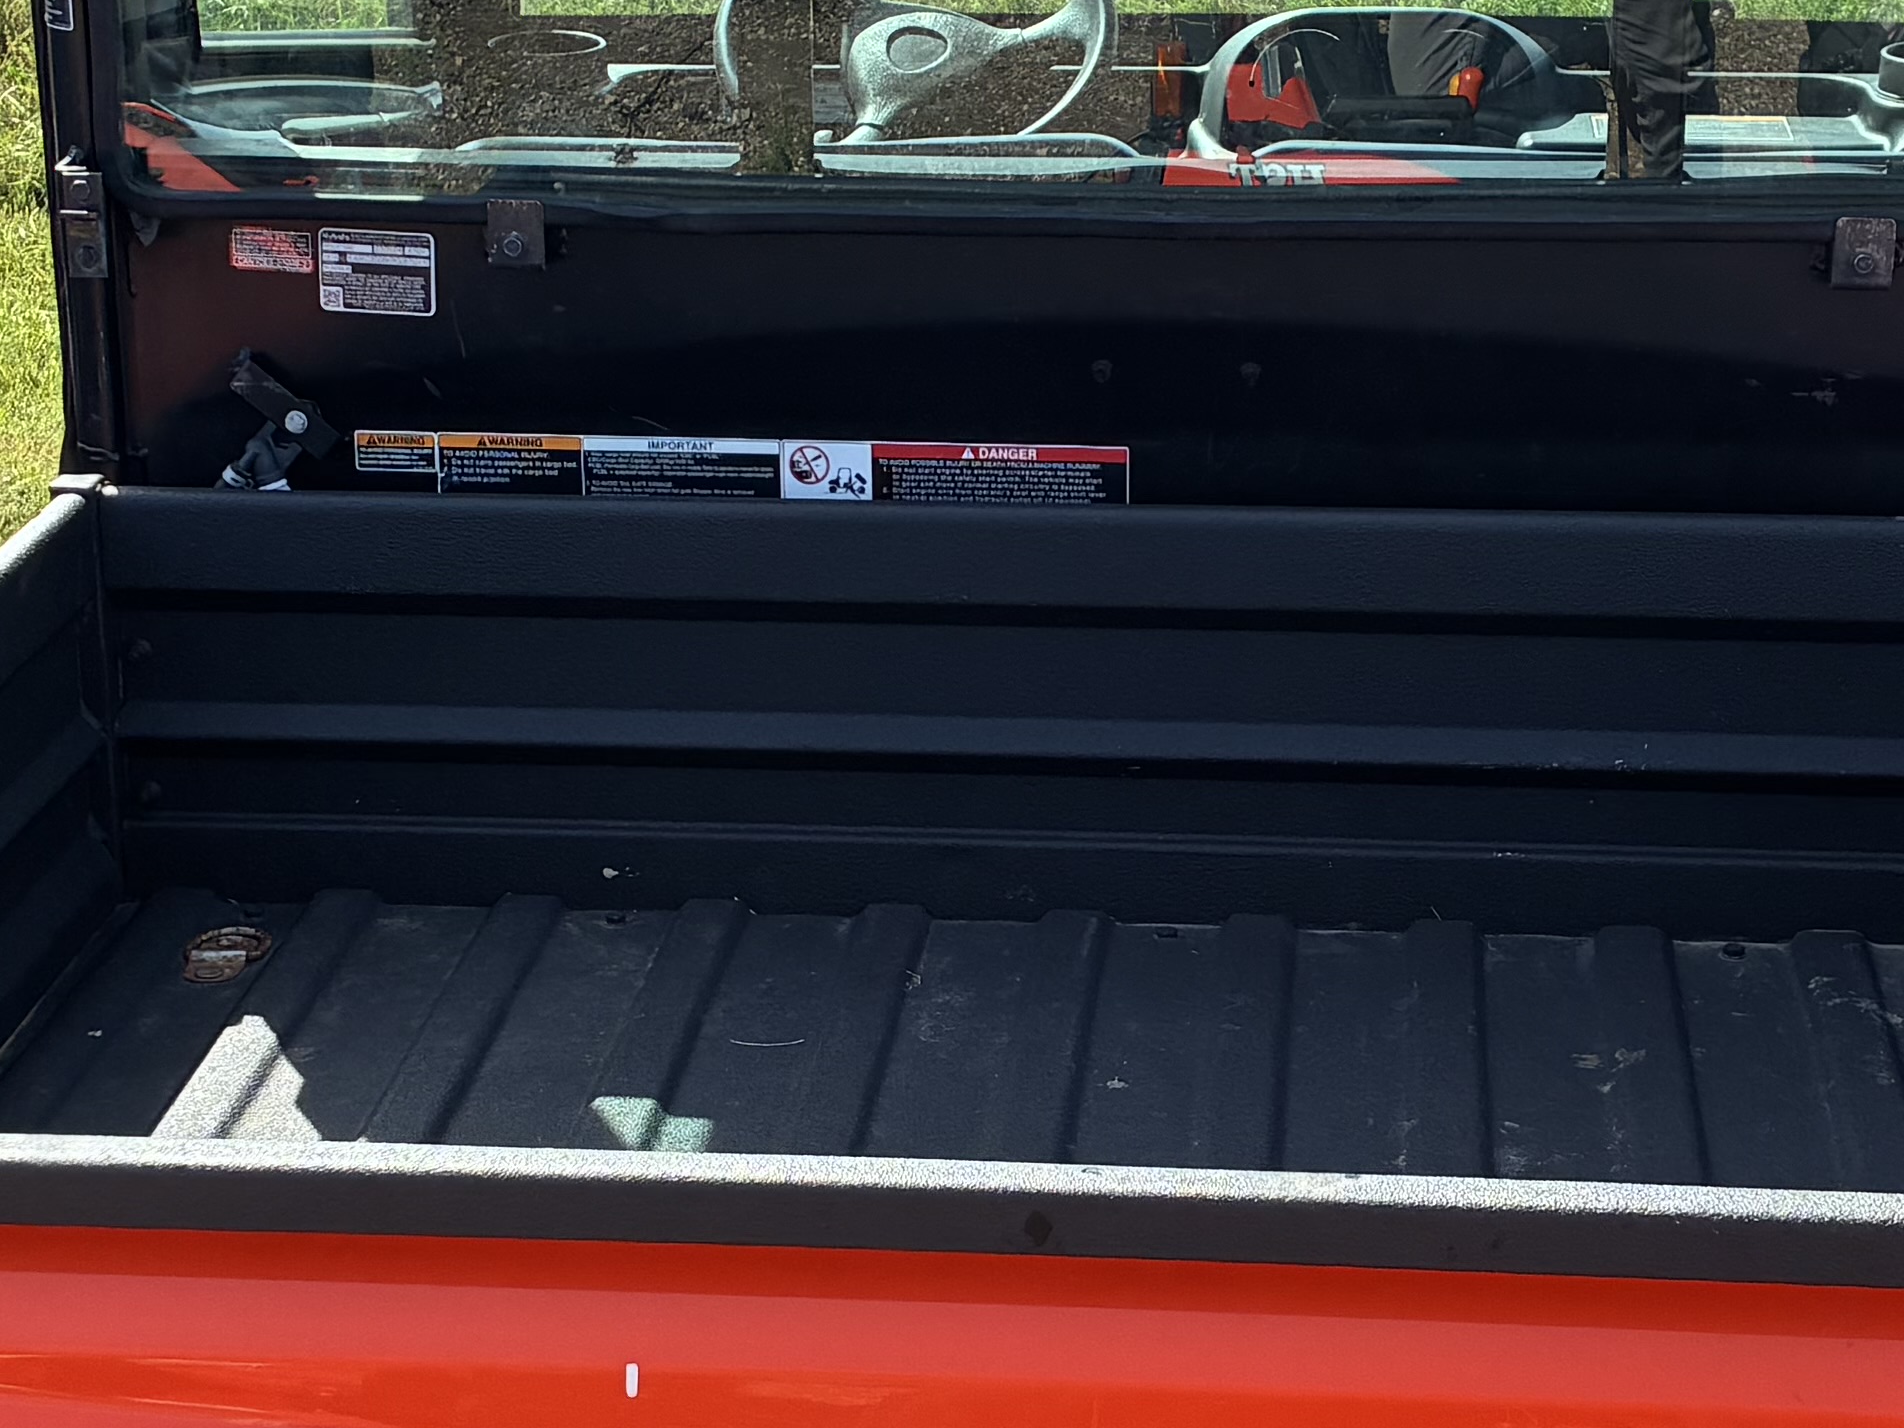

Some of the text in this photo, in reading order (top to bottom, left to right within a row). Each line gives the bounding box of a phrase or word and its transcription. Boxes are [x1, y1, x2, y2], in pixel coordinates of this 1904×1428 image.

[487, 437, 544, 448] WARNING
[647, 439, 715, 452] IMPORTANT
[978, 447, 1038, 461] DANGER
